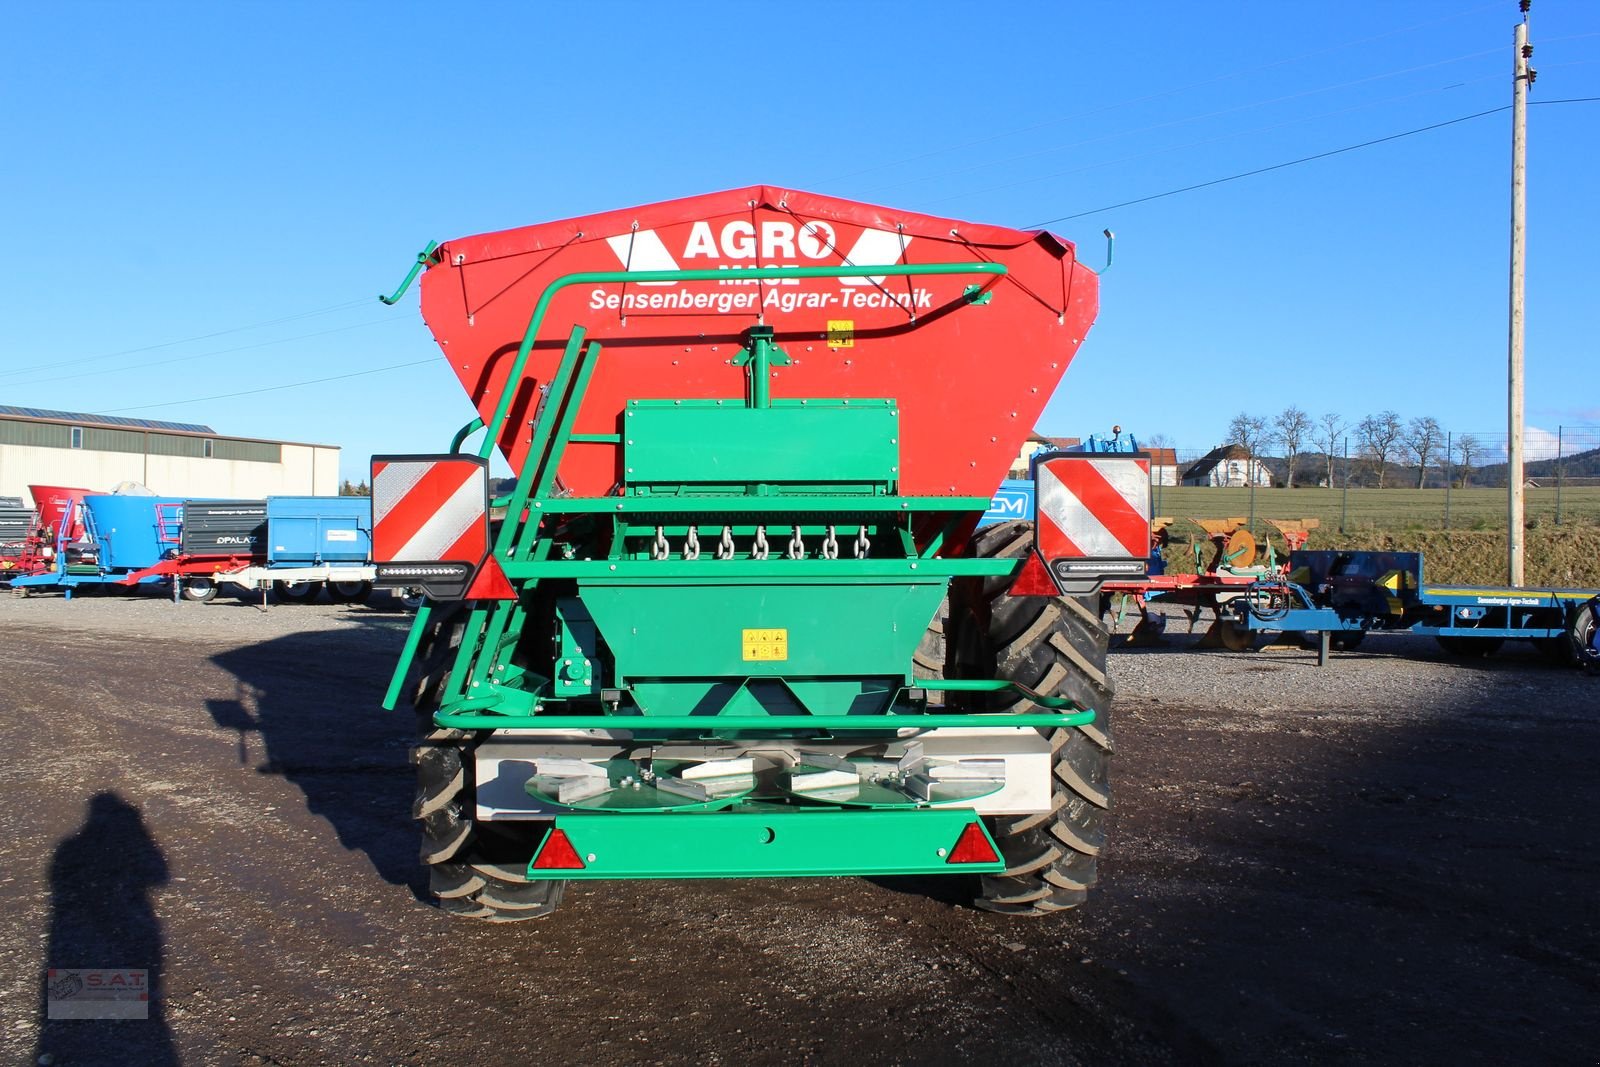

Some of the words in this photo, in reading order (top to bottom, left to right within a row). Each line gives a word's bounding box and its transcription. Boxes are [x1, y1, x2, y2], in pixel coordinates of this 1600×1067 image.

[682, 220, 836, 259] AGRO
[589, 288, 757, 313] Sensenberger
[763, 288, 933, 313] Agrar-Technik
